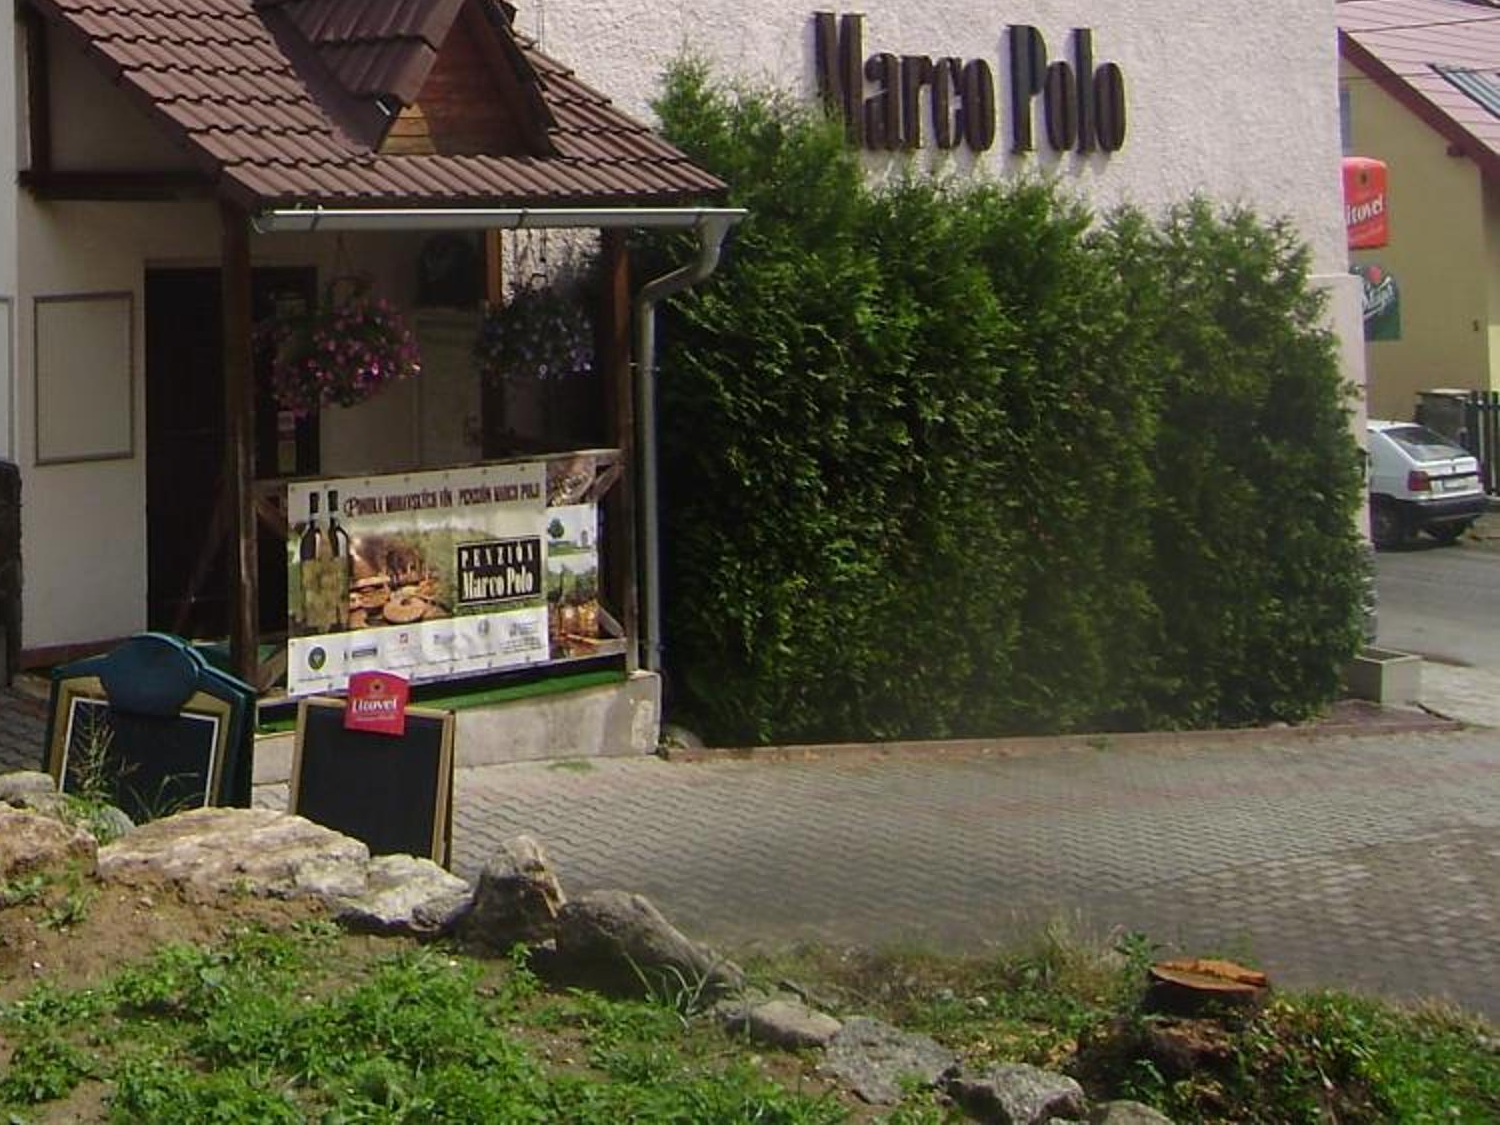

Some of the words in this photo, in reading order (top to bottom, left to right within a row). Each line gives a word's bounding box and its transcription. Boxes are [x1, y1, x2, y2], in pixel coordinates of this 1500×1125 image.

[812, 12, 996, 153] Marco
[1006, 24, 1127, 155] Polo
[1347, 193, 1384, 226] itovel
[462, 571, 505, 600] Marco
[506, 565, 534, 596] Polo
